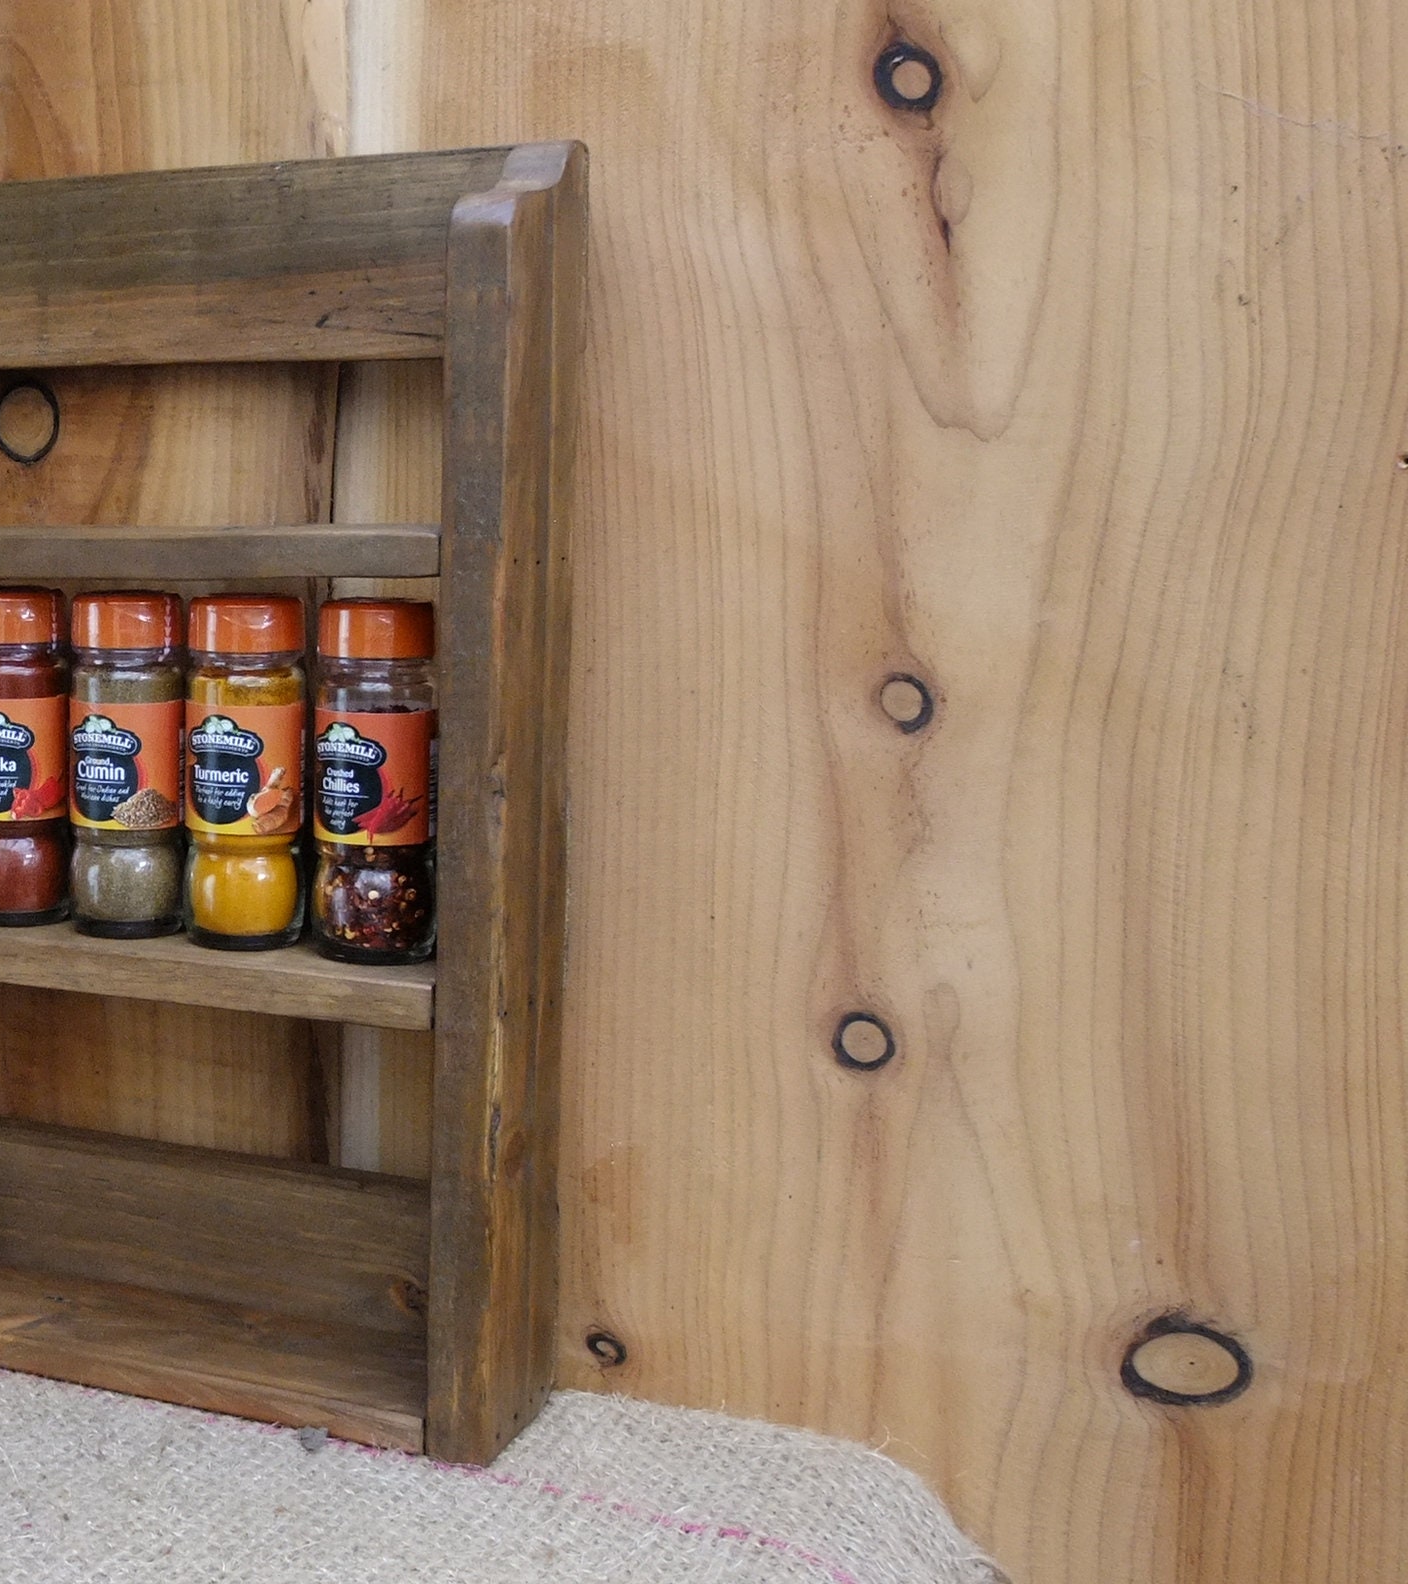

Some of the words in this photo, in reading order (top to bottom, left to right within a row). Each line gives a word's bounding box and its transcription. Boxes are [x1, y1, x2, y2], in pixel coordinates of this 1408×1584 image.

[74, 733, 131, 749] STONEMILL
[192, 734, 254, 750] STONEMILL
[317, 742, 376, 759] STONEMILL
[85, 756, 110, 765] Ground
[78, 760, 125, 780] Cumin
[194, 765, 249, 783] Turmeric
[327, 767, 354, 778] Crushed
[323, 777, 359, 793] Chillies
